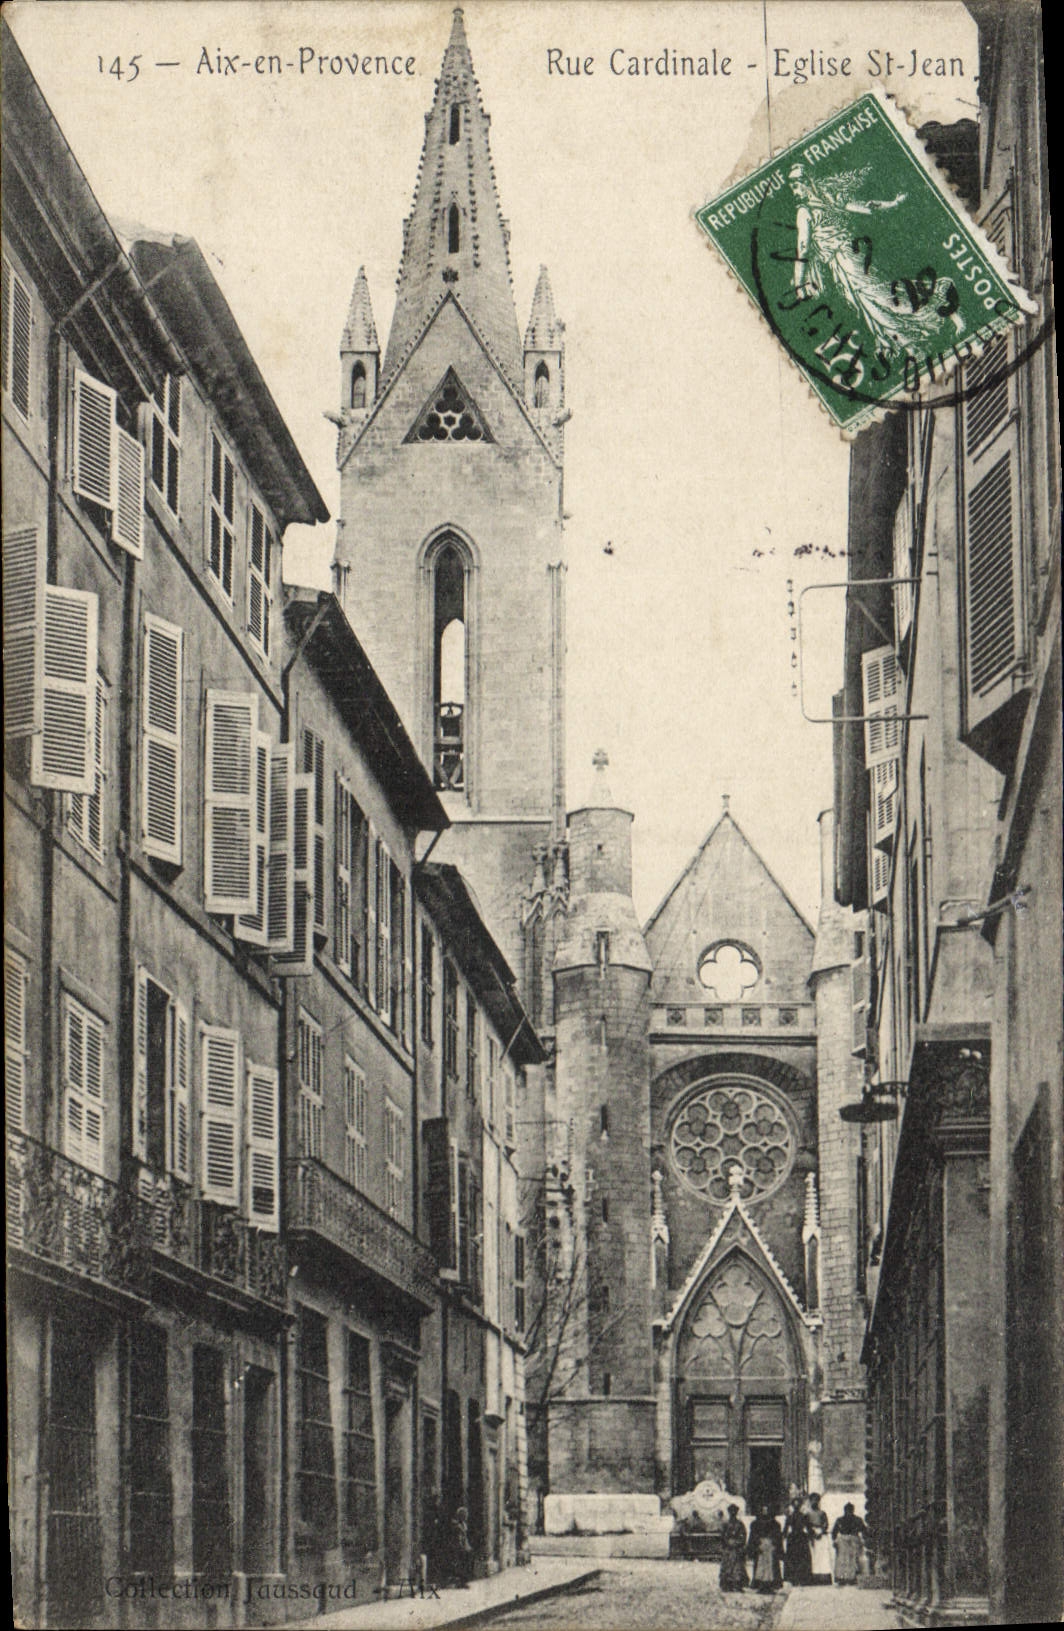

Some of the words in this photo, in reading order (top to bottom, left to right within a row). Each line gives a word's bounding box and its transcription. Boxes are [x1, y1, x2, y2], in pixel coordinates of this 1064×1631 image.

[706, 168, 786, 232] REPUBLIQUE
[802, 106, 879, 166] FRANÇAISE
[942, 232, 1002, 312] POSTES
